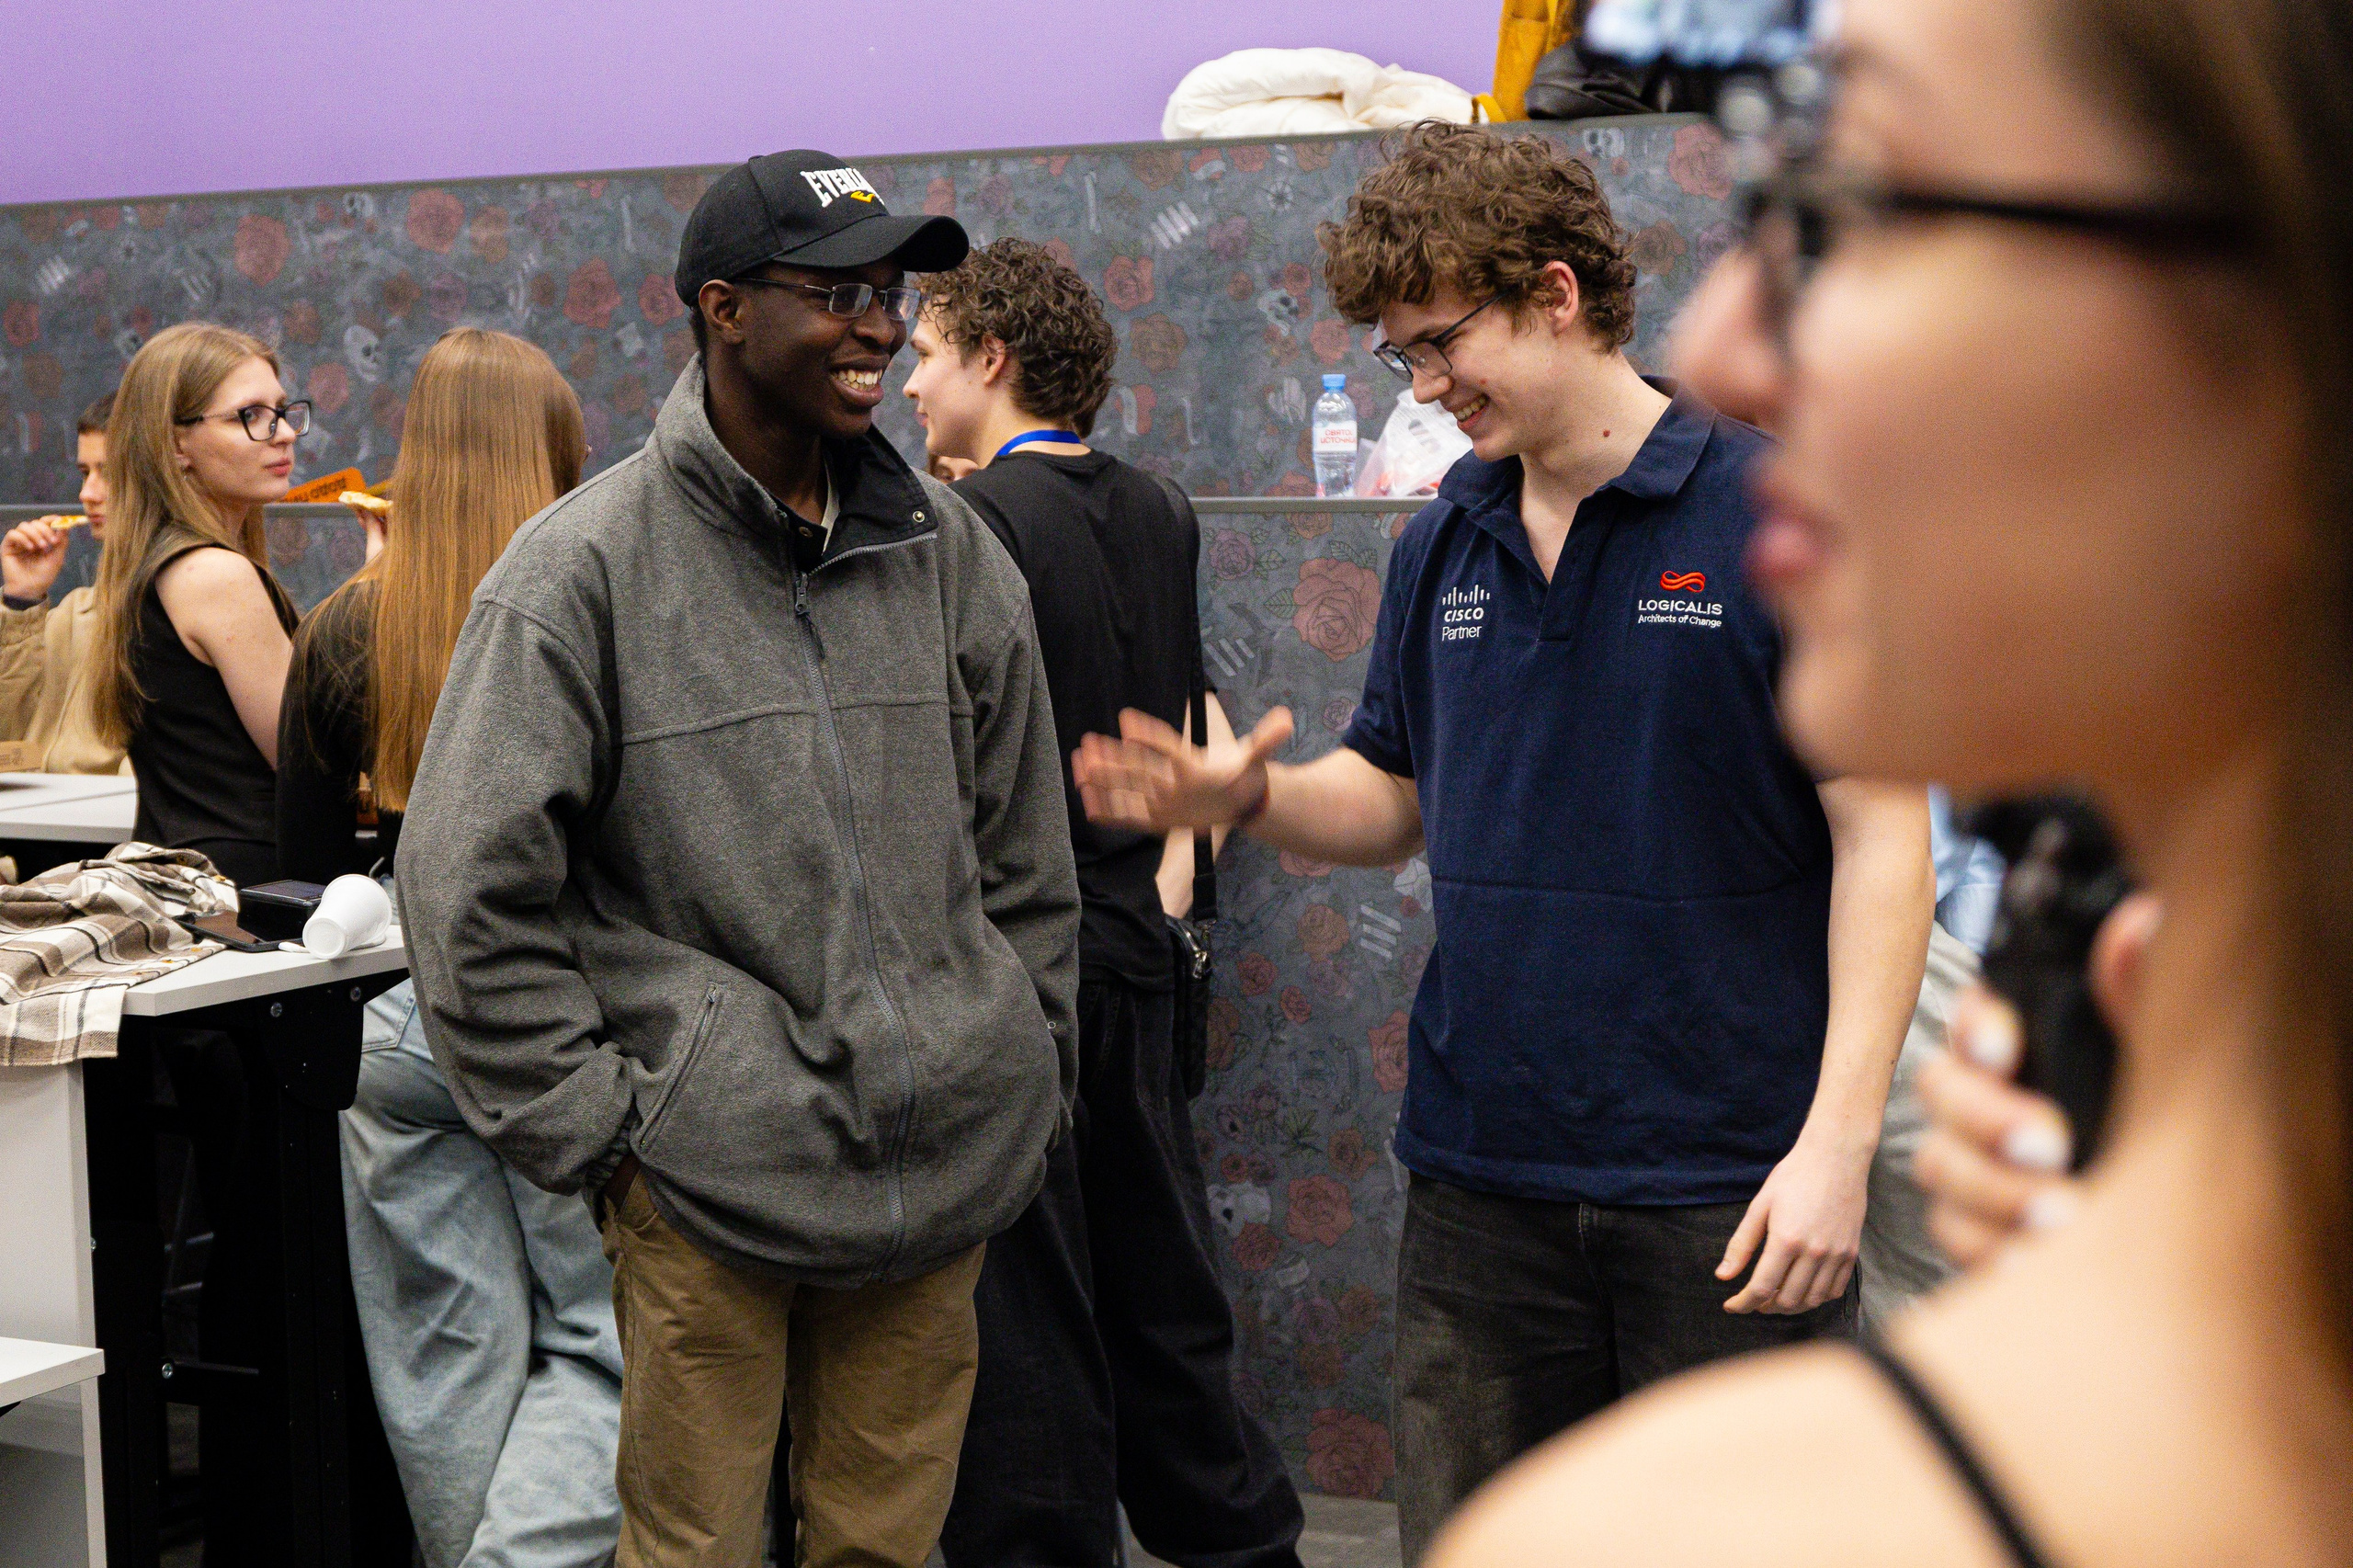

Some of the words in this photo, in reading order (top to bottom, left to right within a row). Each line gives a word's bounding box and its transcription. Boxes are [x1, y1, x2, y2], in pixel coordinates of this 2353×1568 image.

[1638, 599, 1722, 615] LOGICALIS
[1638, 614, 1677, 623] Architects
[1678, 615, 1689, 623] of
[1689, 616, 1722, 629] Change
[1442, 626, 1483, 642] Partner
